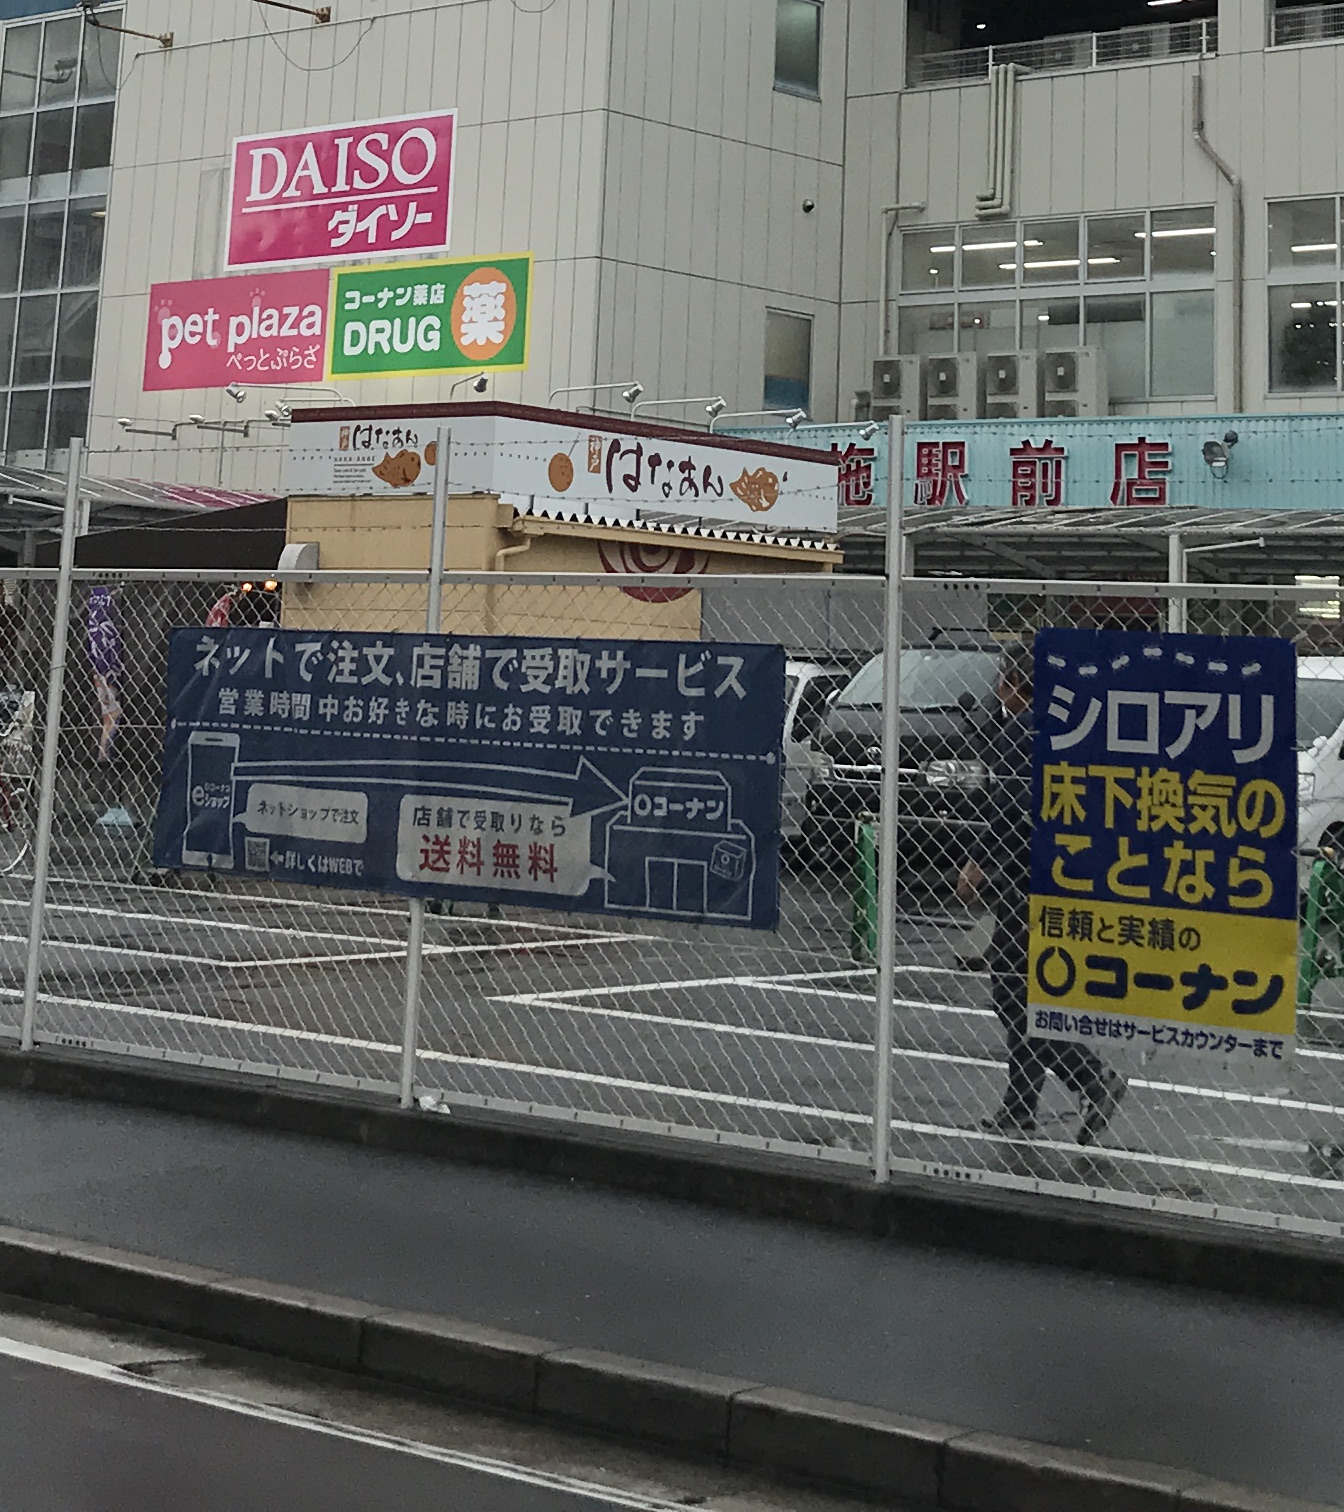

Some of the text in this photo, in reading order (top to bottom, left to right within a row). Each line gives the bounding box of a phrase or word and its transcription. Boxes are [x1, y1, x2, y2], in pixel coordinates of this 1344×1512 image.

[245, 128, 437, 202] DAISO
[327, 201, 432, 248] ダイソー
[343, 282, 445, 310] コーナン薬店
[459, 280, 507, 347] 薬
[158, 300, 322, 369] pet plaza
[226, 345, 321, 372] ぺっとぷらざ
[343, 316, 442, 356] DRUG
[606, 438, 724, 498] はなあん
[831, 437, 1173, 507] 施駅前店
[194, 635, 748, 700] ネットで注文、店舗で受取サービス
[1047, 685, 1275, 764] シロアリ
[257, 800, 360, 825] ネットショップで注文
[412, 804, 567, 838] 店舗で受取りなら
[653, 796, 725, 820] コーナン
[1040, 761, 1286, 840] 床下換気の
[418, 833, 559, 884] 送料無料
[1051, 832, 1274, 910] ことなら
[1038, 904, 1201, 953] 信頼と実績の
[1084, 953, 1285, 1016] コーナン
[1034, 1009, 1285, 1061] お問い合せはサービスカウンターまで
